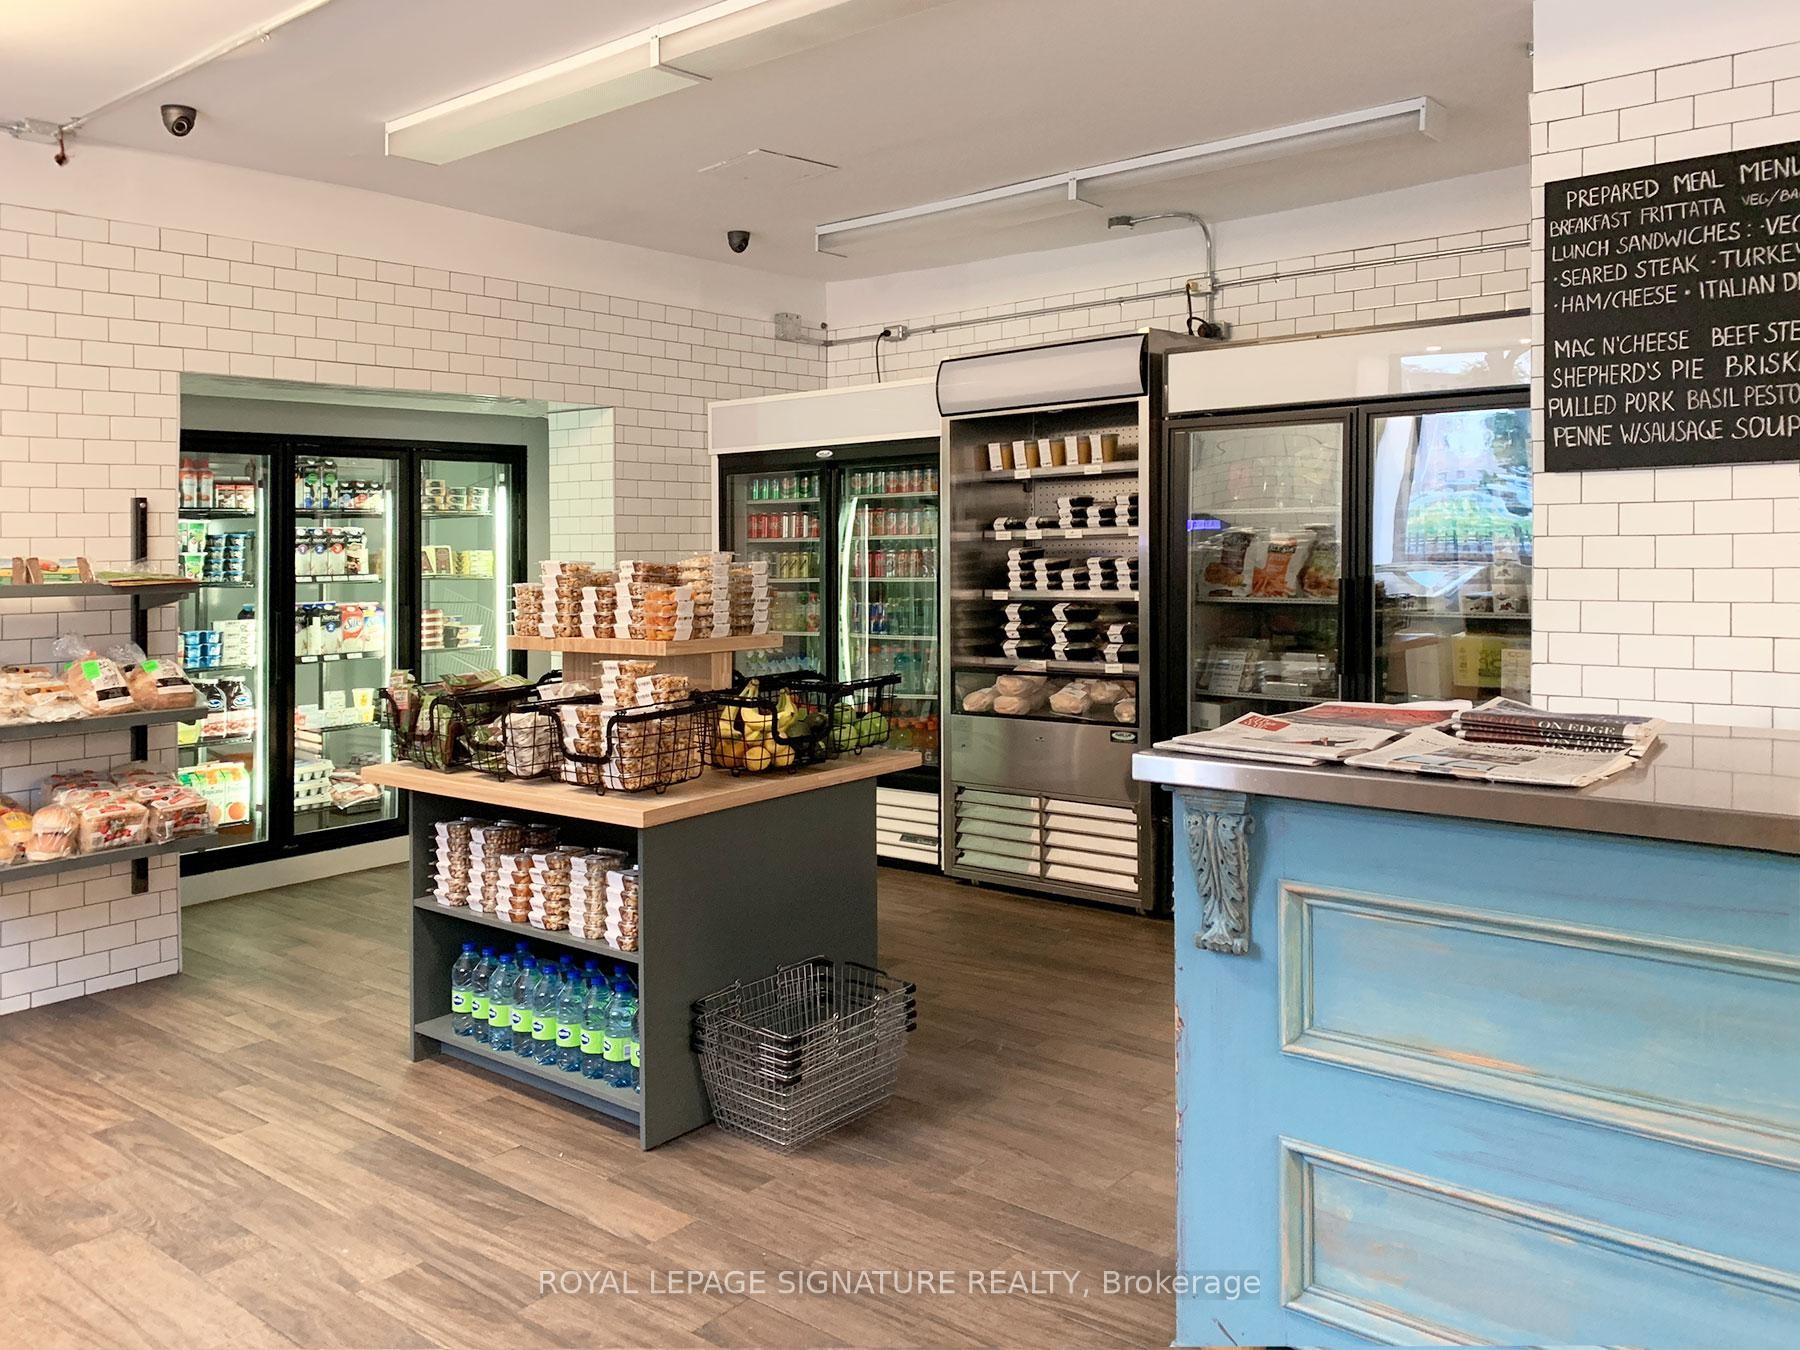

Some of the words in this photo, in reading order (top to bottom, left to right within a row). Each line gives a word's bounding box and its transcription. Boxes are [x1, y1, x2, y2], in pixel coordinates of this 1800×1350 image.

[1566, 179, 1660, 210] PREPARED
[1673, 169, 1725, 194] MEAL
[1549, 211, 1631, 238] BREAKFAST
[1640, 198, 1726, 225] FRITTATA
[1742, 188, 1800, 207] VEG/BA
[1551, 240, 1610, 262] LUNCH
[1634, 254, 1699, 279] STEAK
[1699, 274, 1776, 299] ITALIAN
[1783, 271, 1800, 292] D
[1554, 338, 1596, 359] MAC
[1602, 329, 1690, 355] N'CHEESE
[1711, 323, 1760, 347] BEEF
[1551, 361, 1662, 388] SHEPHERD'S
[1672, 358, 1704, 379] PIE
[1725, 350, 1800, 378] BRISK
[1548, 394, 1617, 419] PULLED
[1625, 390, 1675, 414] PORK
[1687, 387, 1740, 410] BASIL
[1744, 382, 1800, 407] PESTO
[1553, 425, 1613, 448] PENNE
[1620, 419, 1724, 444] W/SAUSAGE
[1731, 414, 1800, 439] SOUP
[1538, 720, 1563, 730] ON
[1568, 723, 1616, 736] EDGE
